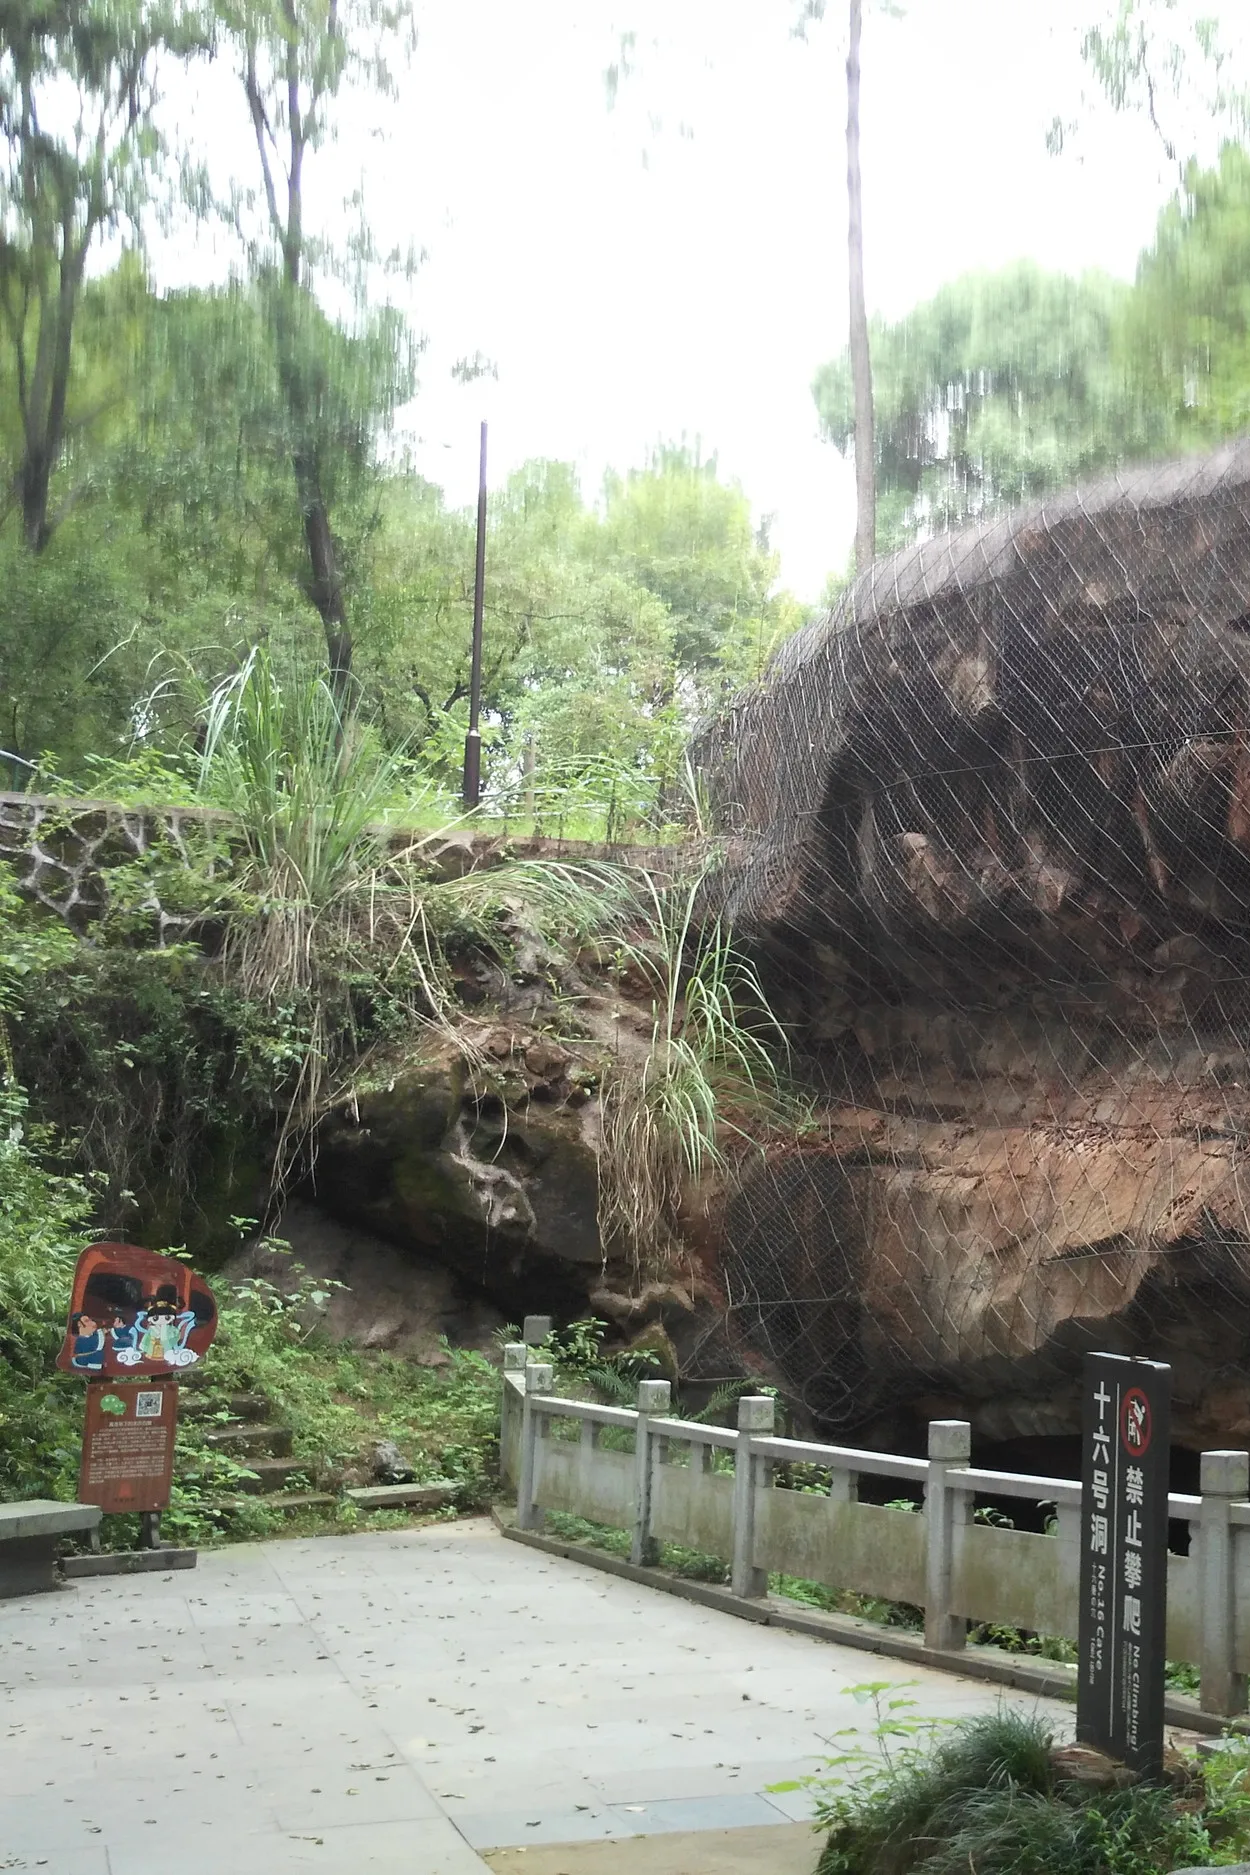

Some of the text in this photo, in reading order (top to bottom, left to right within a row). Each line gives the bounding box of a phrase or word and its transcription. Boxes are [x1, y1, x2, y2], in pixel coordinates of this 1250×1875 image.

[1090, 1381, 1111, 1555] 十六号洞
[1095, 1565, 1106, 1671] No.16 Cave
[1123, 1465, 1144, 1636] 禁止攀爬
[1131, 1645, 1140, 1669] No
